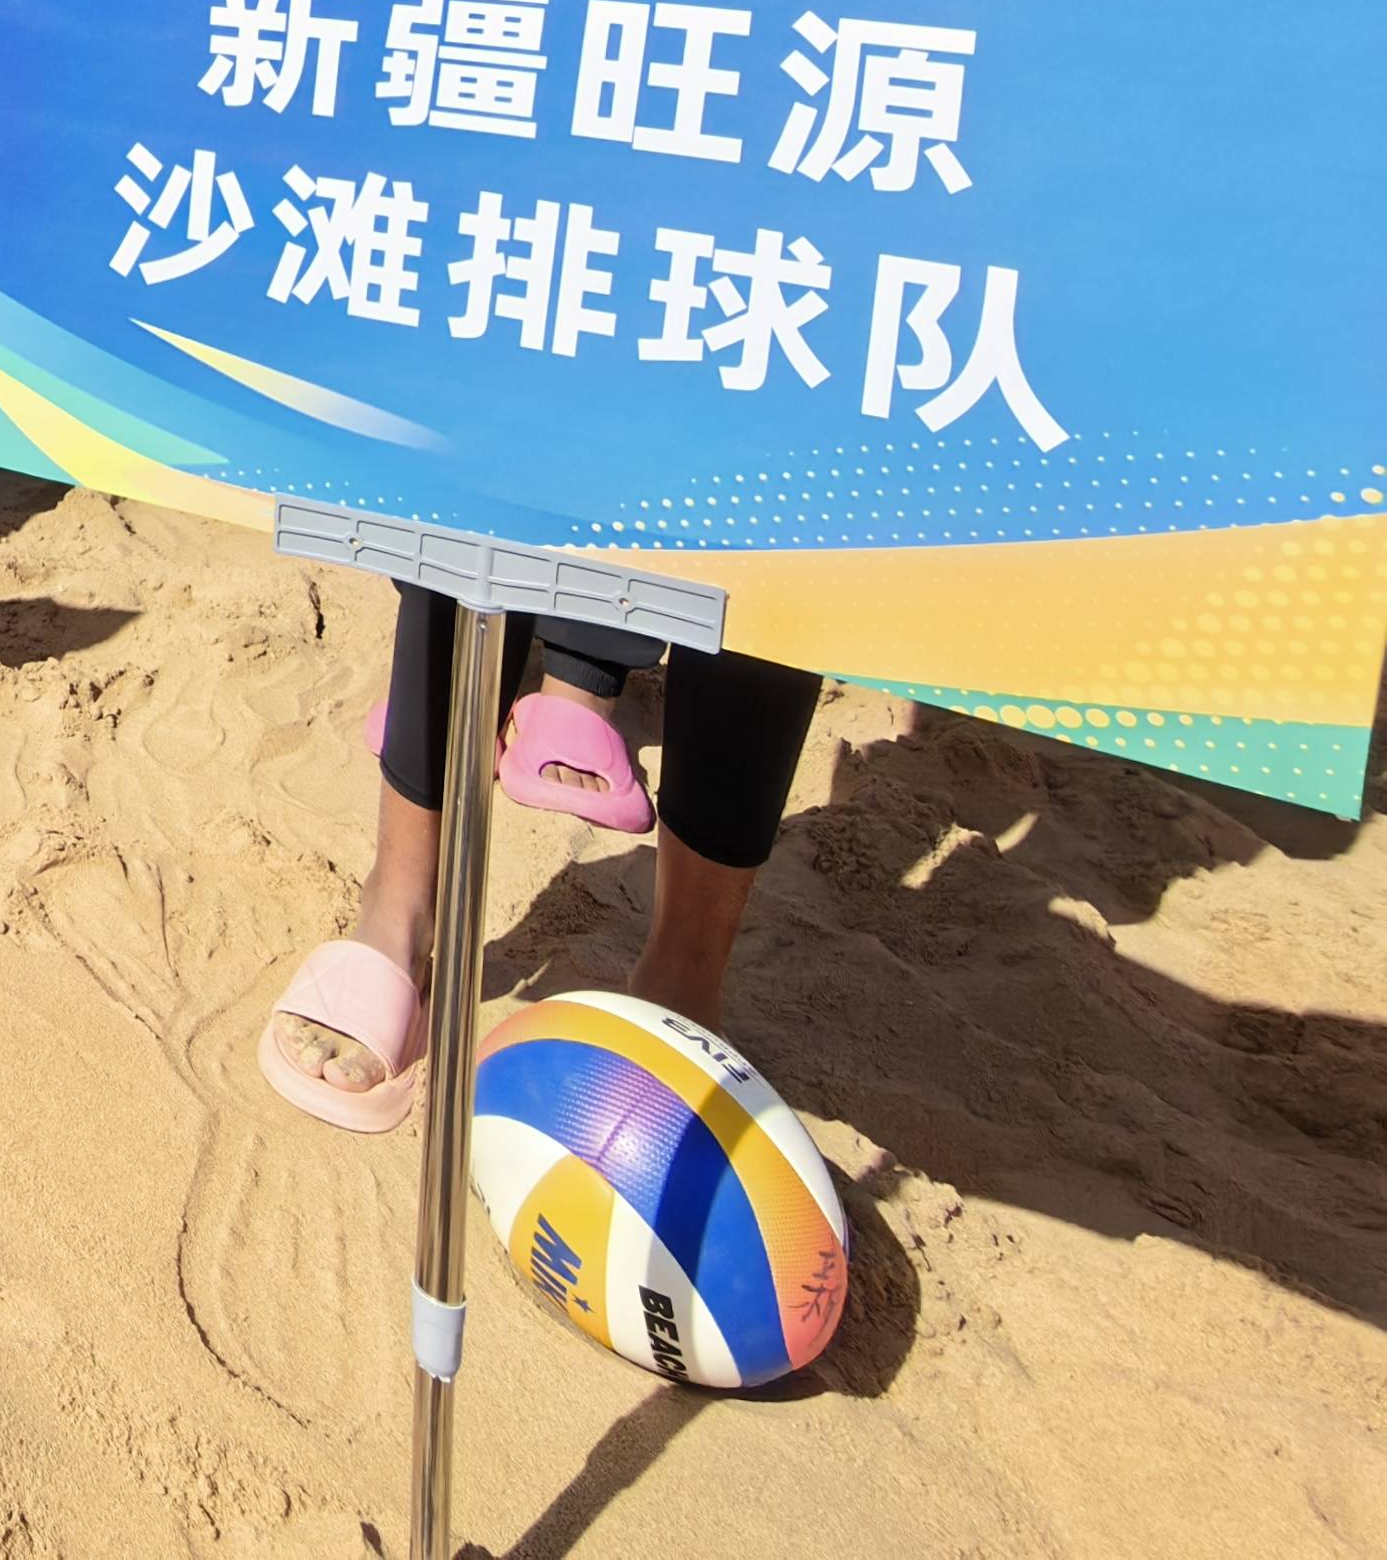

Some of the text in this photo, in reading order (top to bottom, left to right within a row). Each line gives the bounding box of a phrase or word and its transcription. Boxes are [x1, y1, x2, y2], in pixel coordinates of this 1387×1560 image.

[107, 141, 1070, 453] 沙滩排球队
